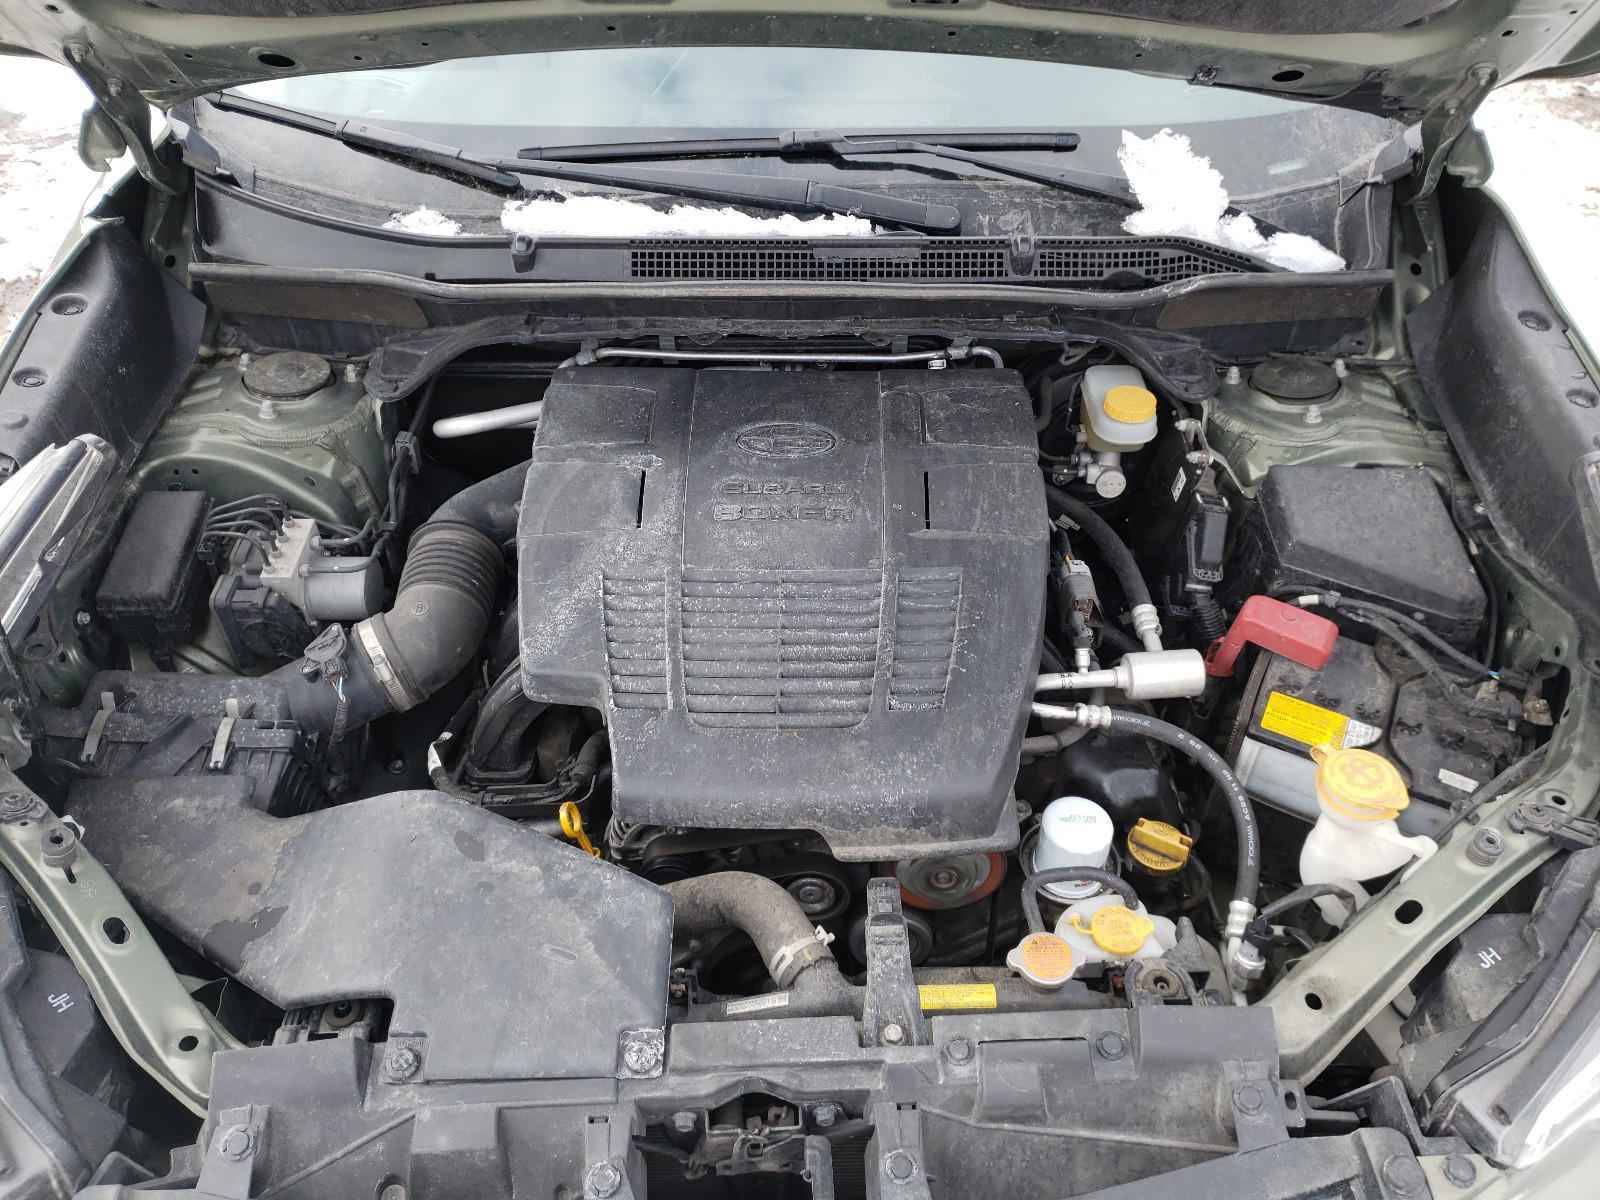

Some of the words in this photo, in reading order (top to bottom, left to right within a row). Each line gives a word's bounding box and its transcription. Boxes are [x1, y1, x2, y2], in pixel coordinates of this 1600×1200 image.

[720, 481, 847, 495] SUBARU
[713, 504, 854, 521] BOXER
[1477, 946, 1503, 969] JH
[47, 992, 75, 1014] JH
